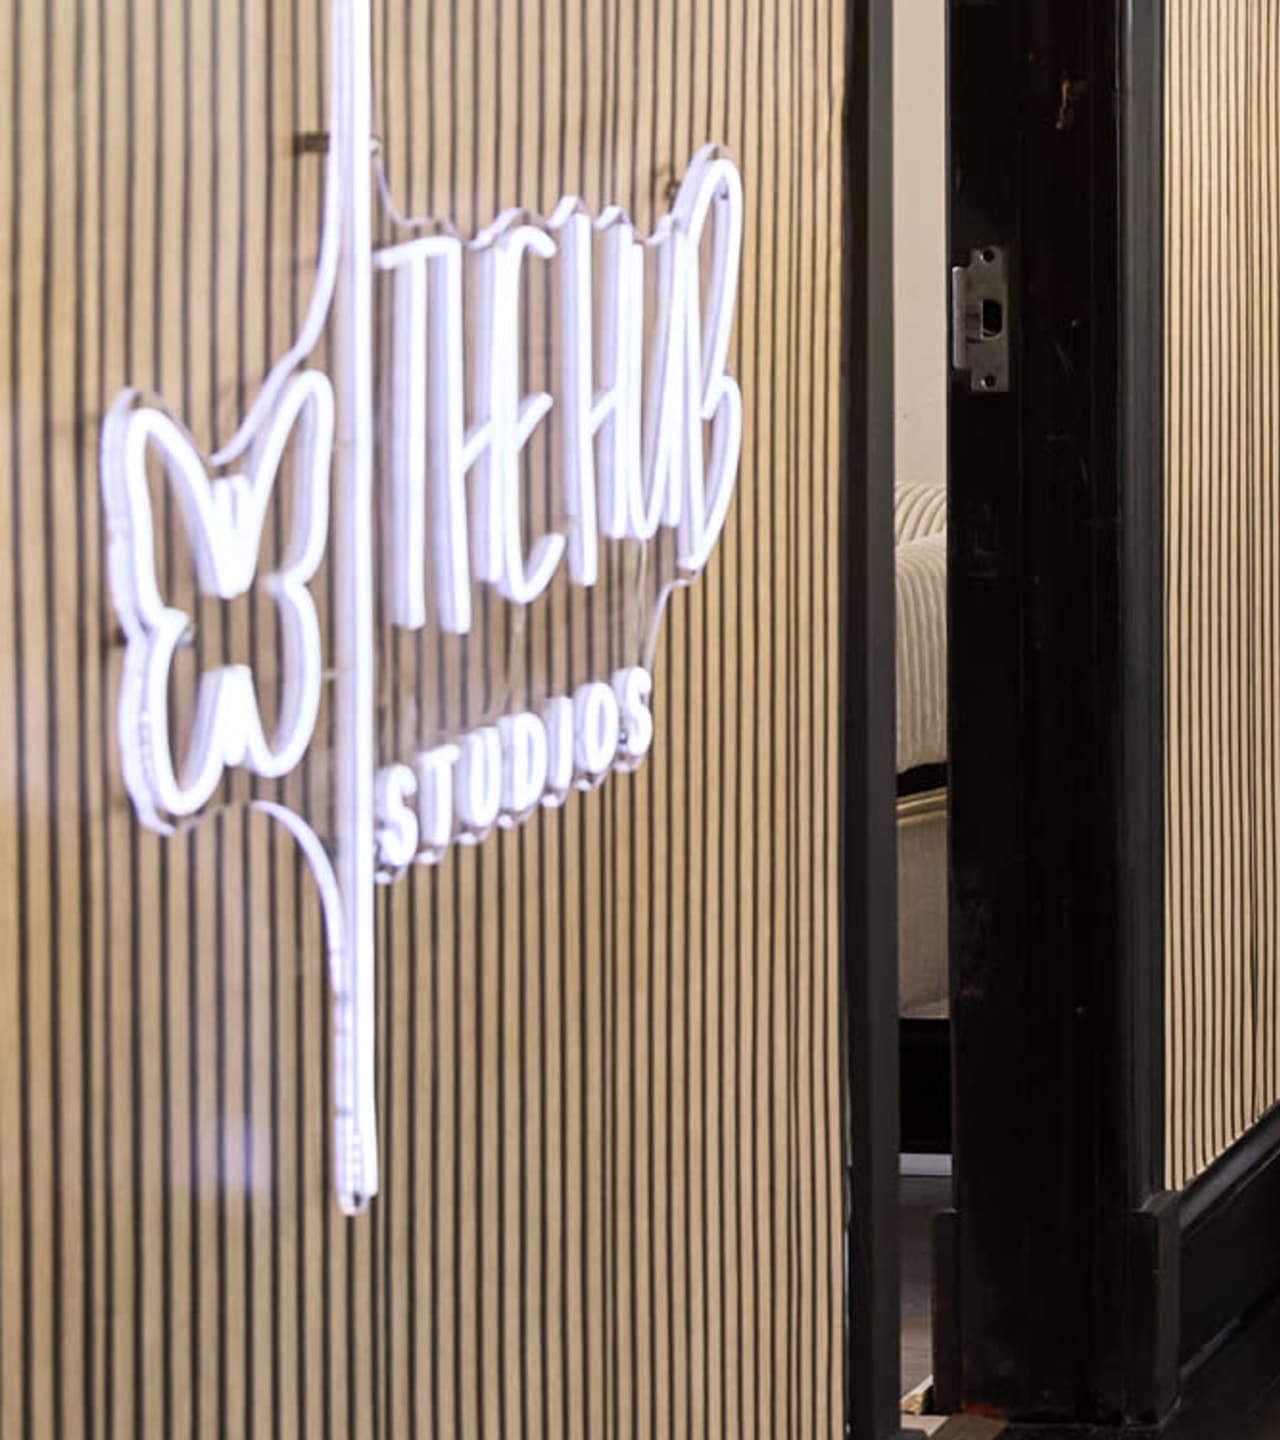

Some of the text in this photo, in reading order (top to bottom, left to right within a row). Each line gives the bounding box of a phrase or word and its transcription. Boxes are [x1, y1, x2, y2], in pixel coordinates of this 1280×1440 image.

[374, 155, 744, 635] THE HUB
[374, 666, 653, 872] STUDIOS
